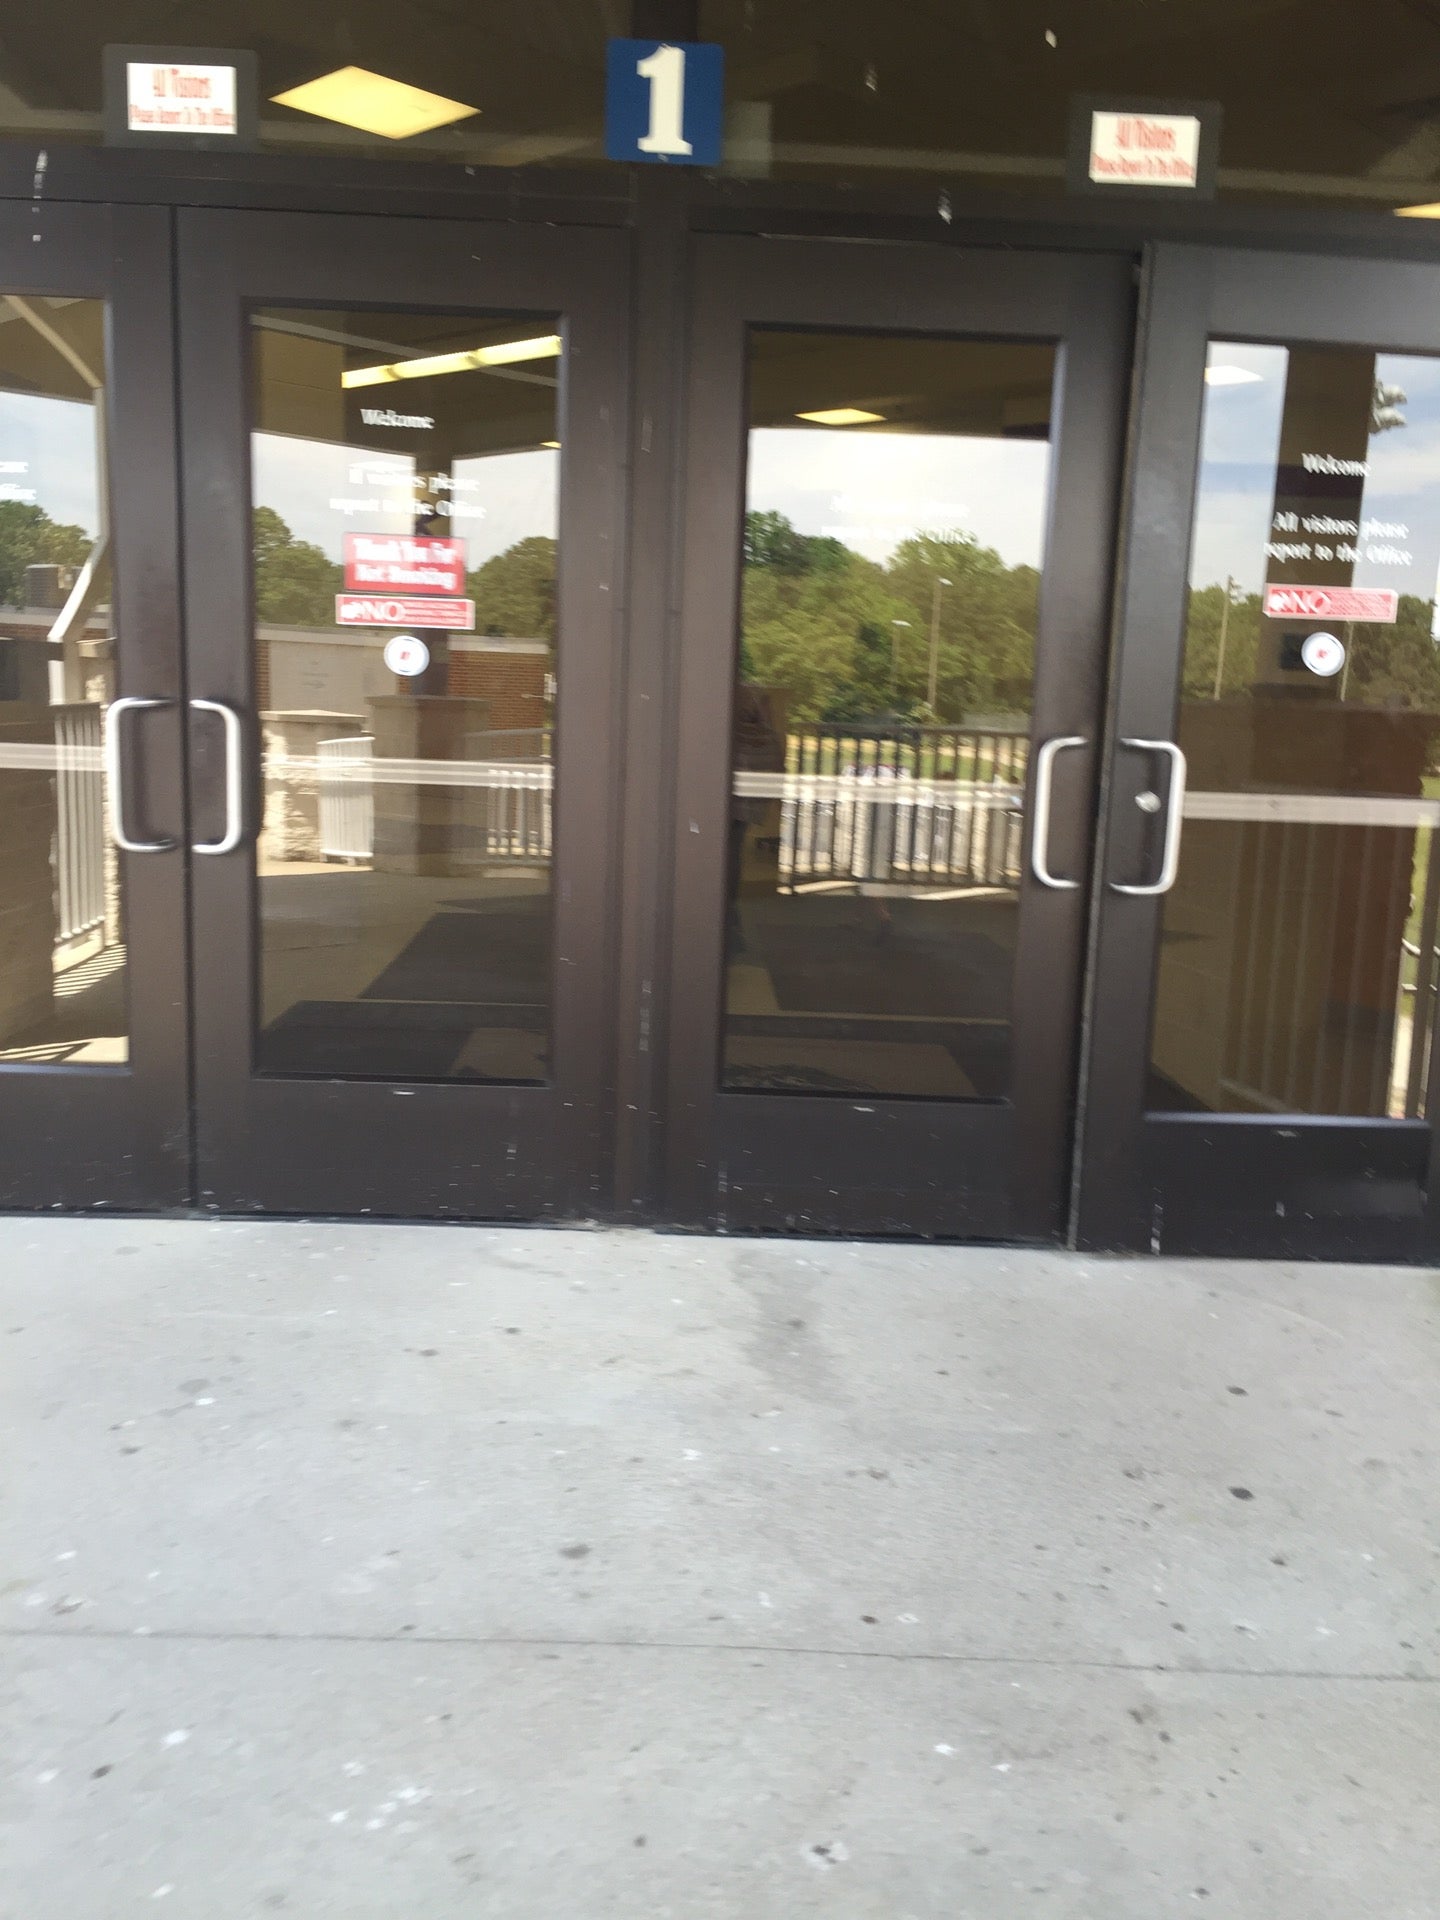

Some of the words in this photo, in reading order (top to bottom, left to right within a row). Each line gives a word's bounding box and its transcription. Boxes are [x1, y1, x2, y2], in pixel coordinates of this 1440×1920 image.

[637, 43, 693, 156] 1
[360, 408, 436, 429] Welcome
[1272, 511, 1299, 533] All
[1301, 514, 1358, 537] visitors
[1314, 543, 1334, 562] to
